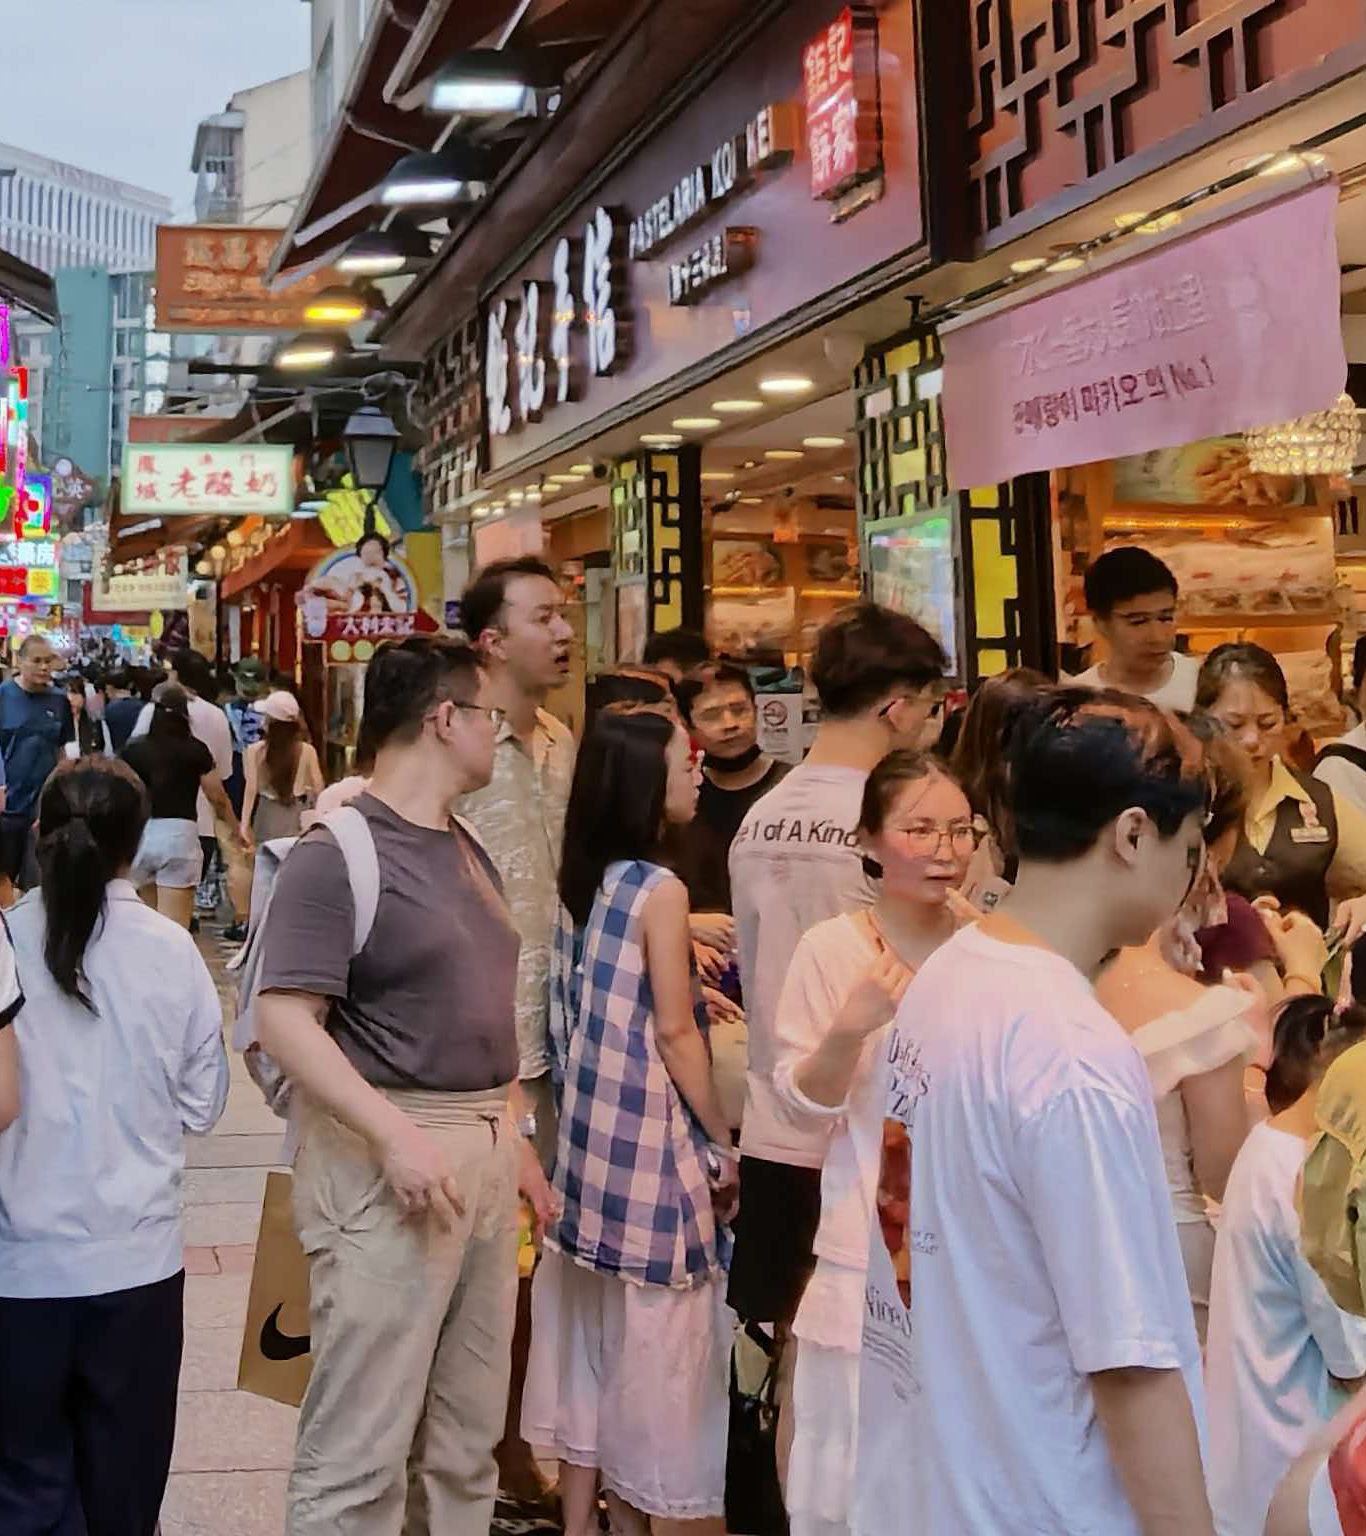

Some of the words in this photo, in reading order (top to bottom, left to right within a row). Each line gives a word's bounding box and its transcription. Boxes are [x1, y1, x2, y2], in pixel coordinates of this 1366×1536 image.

[629, 166, 707, 260] PASTELARIA
[170, 465, 278, 498] 老酸奶
[764, 818, 786, 841] of
[787, 819, 802, 842] A
